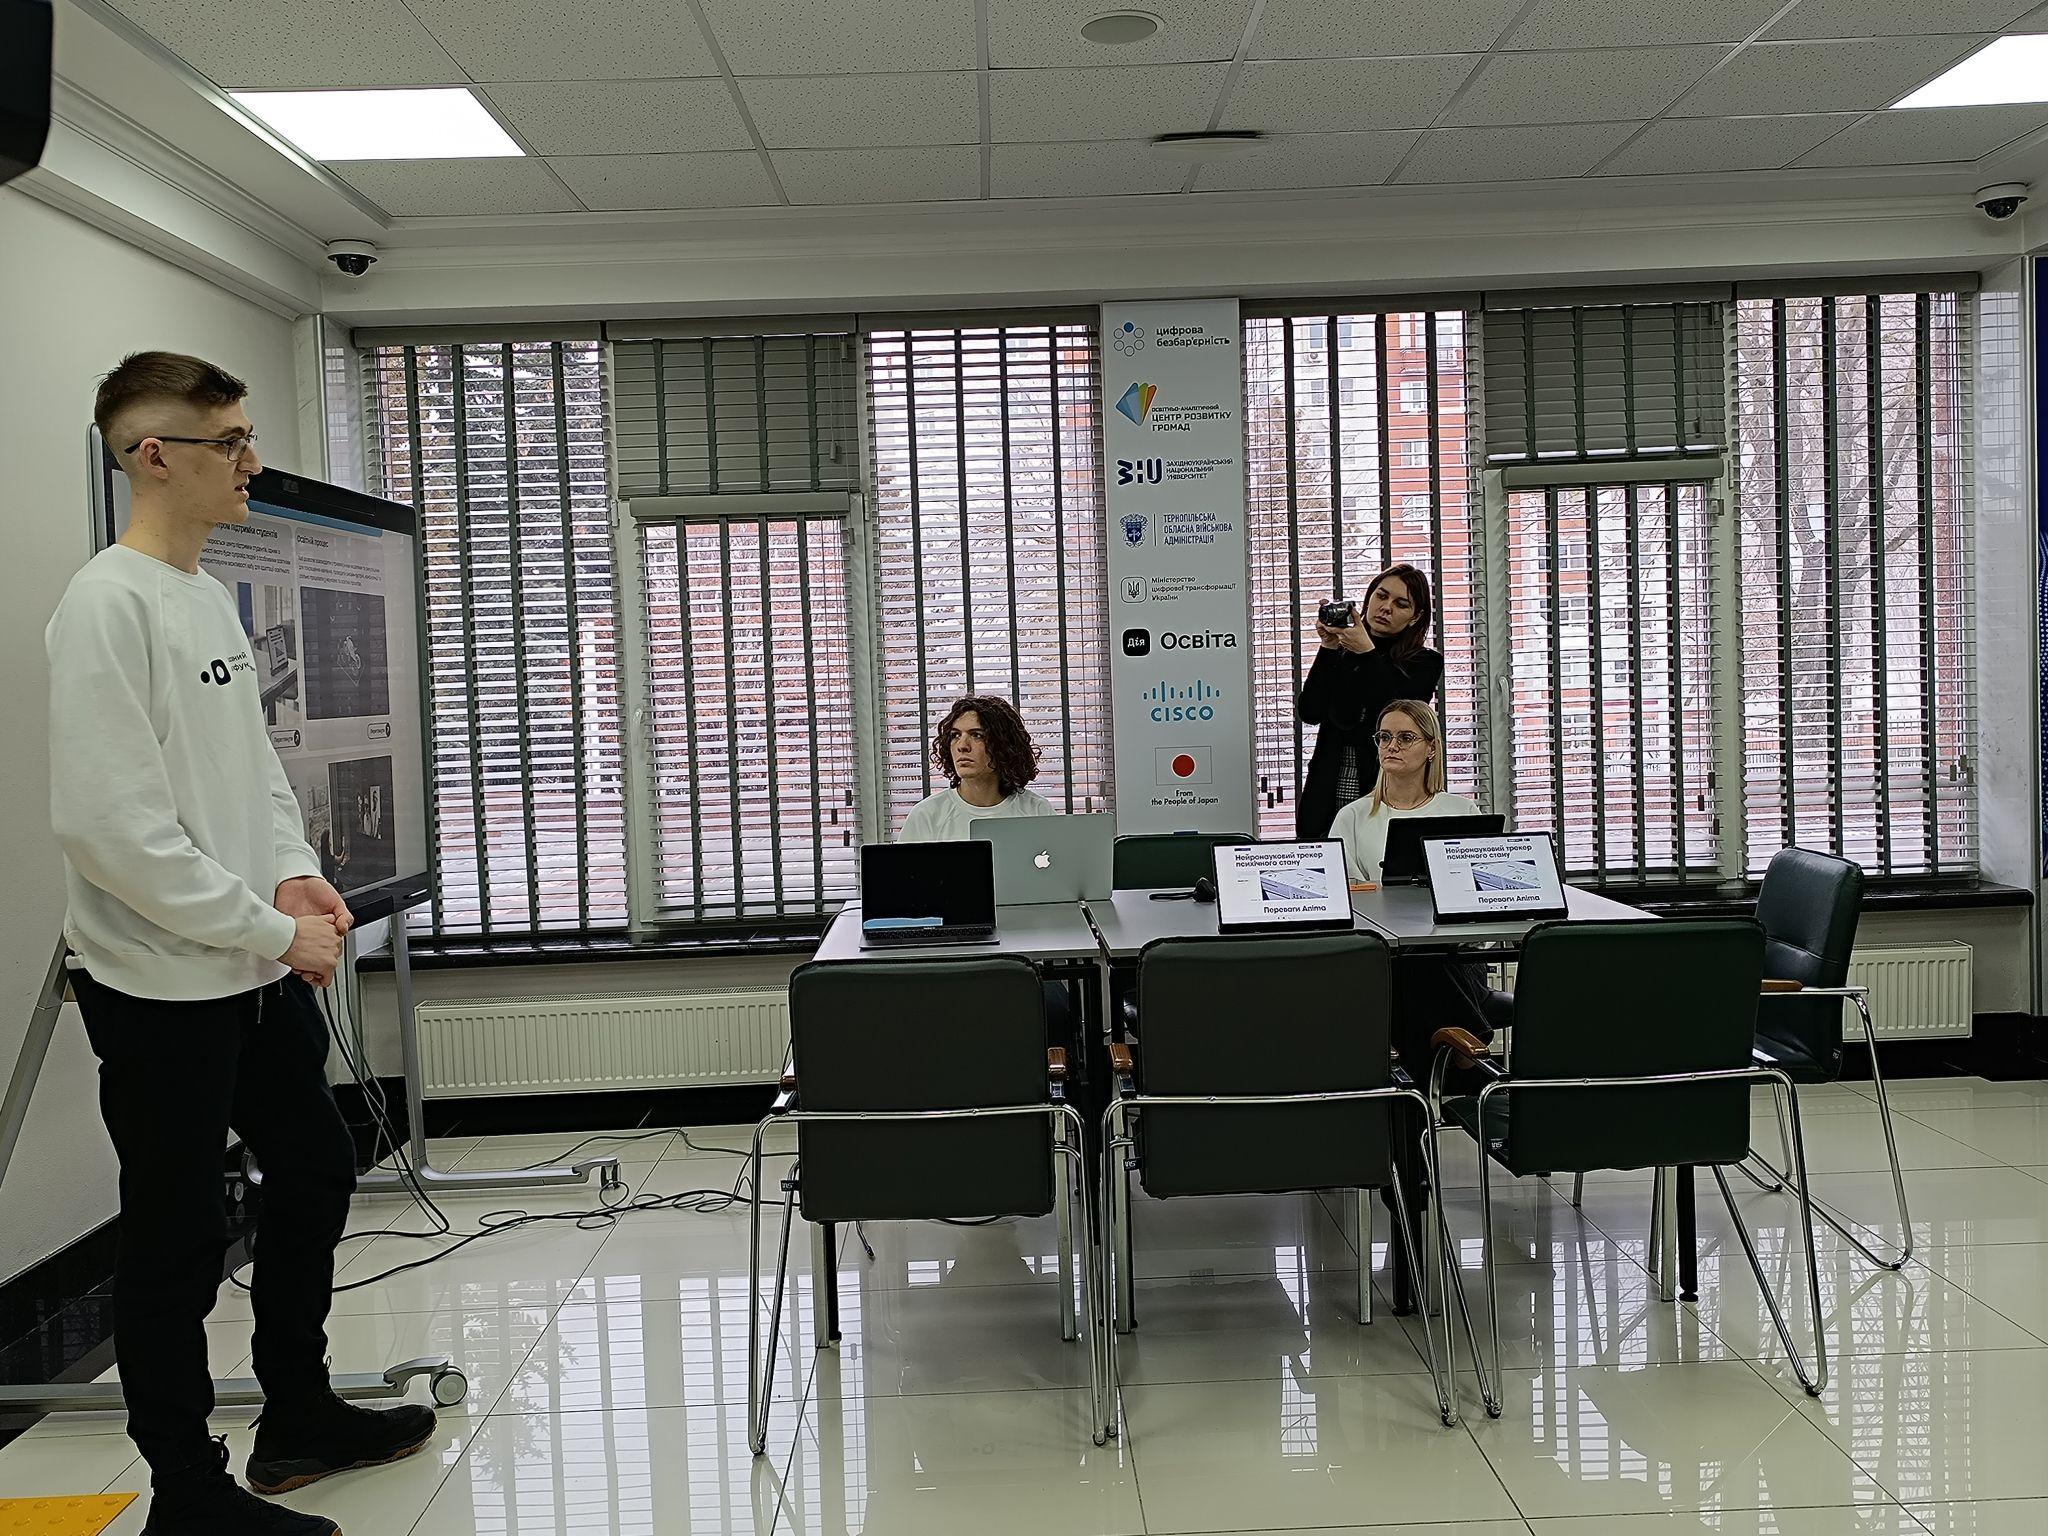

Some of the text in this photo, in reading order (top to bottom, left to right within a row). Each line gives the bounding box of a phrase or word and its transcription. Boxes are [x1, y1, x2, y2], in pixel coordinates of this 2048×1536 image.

[1156, 326, 1204, 336] цифрова
[1152, 411, 1232, 422] ЦЕНТР РОЗВИТКУ
[1152, 423, 1191, 431] ГРОМАД
[1166, 465, 1214, 473] НАЦІОНАЛЬНИЙ
[1164, 513, 1216, 523] ТЕРНОПІЛЬСЬКА
[1164, 523, 1233, 534] ОБЛАСНА ВІЙСЬКОВА
[1164, 535, 1214, 545] АДМІНІСТРАЦІЯ
[1186, 583, 1236, 592] трансформації
[1128, 630, 1237, 649] Дія Освіта
[1151, 705, 1214, 722] CISCO
[1176, 789, 1193, 797] From
[1164, 797, 1187, 806] People
[1188, 796, 1196, 804] of
[1197, 797, 1218, 805] Japan
[1445, 845, 1504, 854] Нейронауковий
[1235, 851, 1296, 861] Нейронауковий
[1478, 896, 1514, 904] Переваги
[1263, 905, 1300, 914] Переваги
